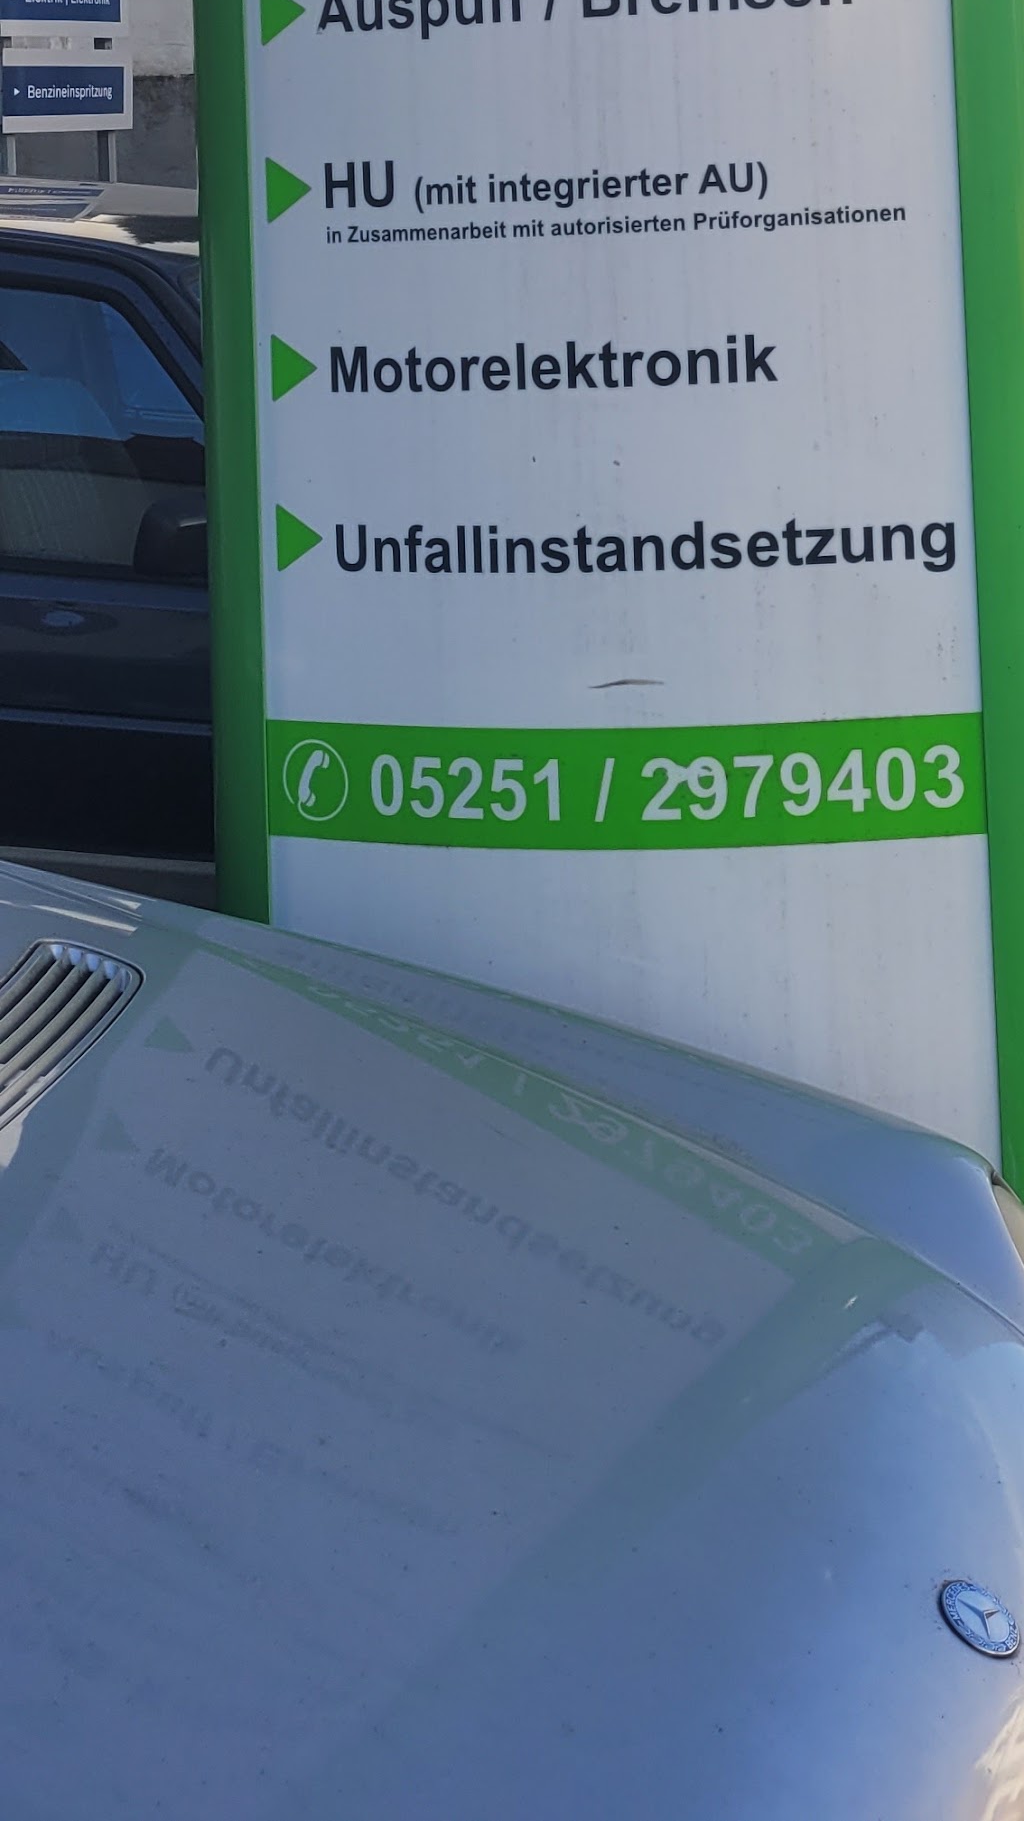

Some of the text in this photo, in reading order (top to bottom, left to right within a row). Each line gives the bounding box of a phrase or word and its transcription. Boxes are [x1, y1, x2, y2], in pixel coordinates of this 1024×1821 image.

[27, 85, 113, 100] Benzineinspritzung
[324, 160, 768, 214] HU (mit integrierter AU)
[326, 205, 906, 244] in Zusammenarbeit mit autorisierten Prüforganisationen
[330, 334, 778, 393] Motorelektronik
[335, 519, 956, 573] Unfallinstandsetzung
[370, 744, 965, 822] 05251 / 2979403
